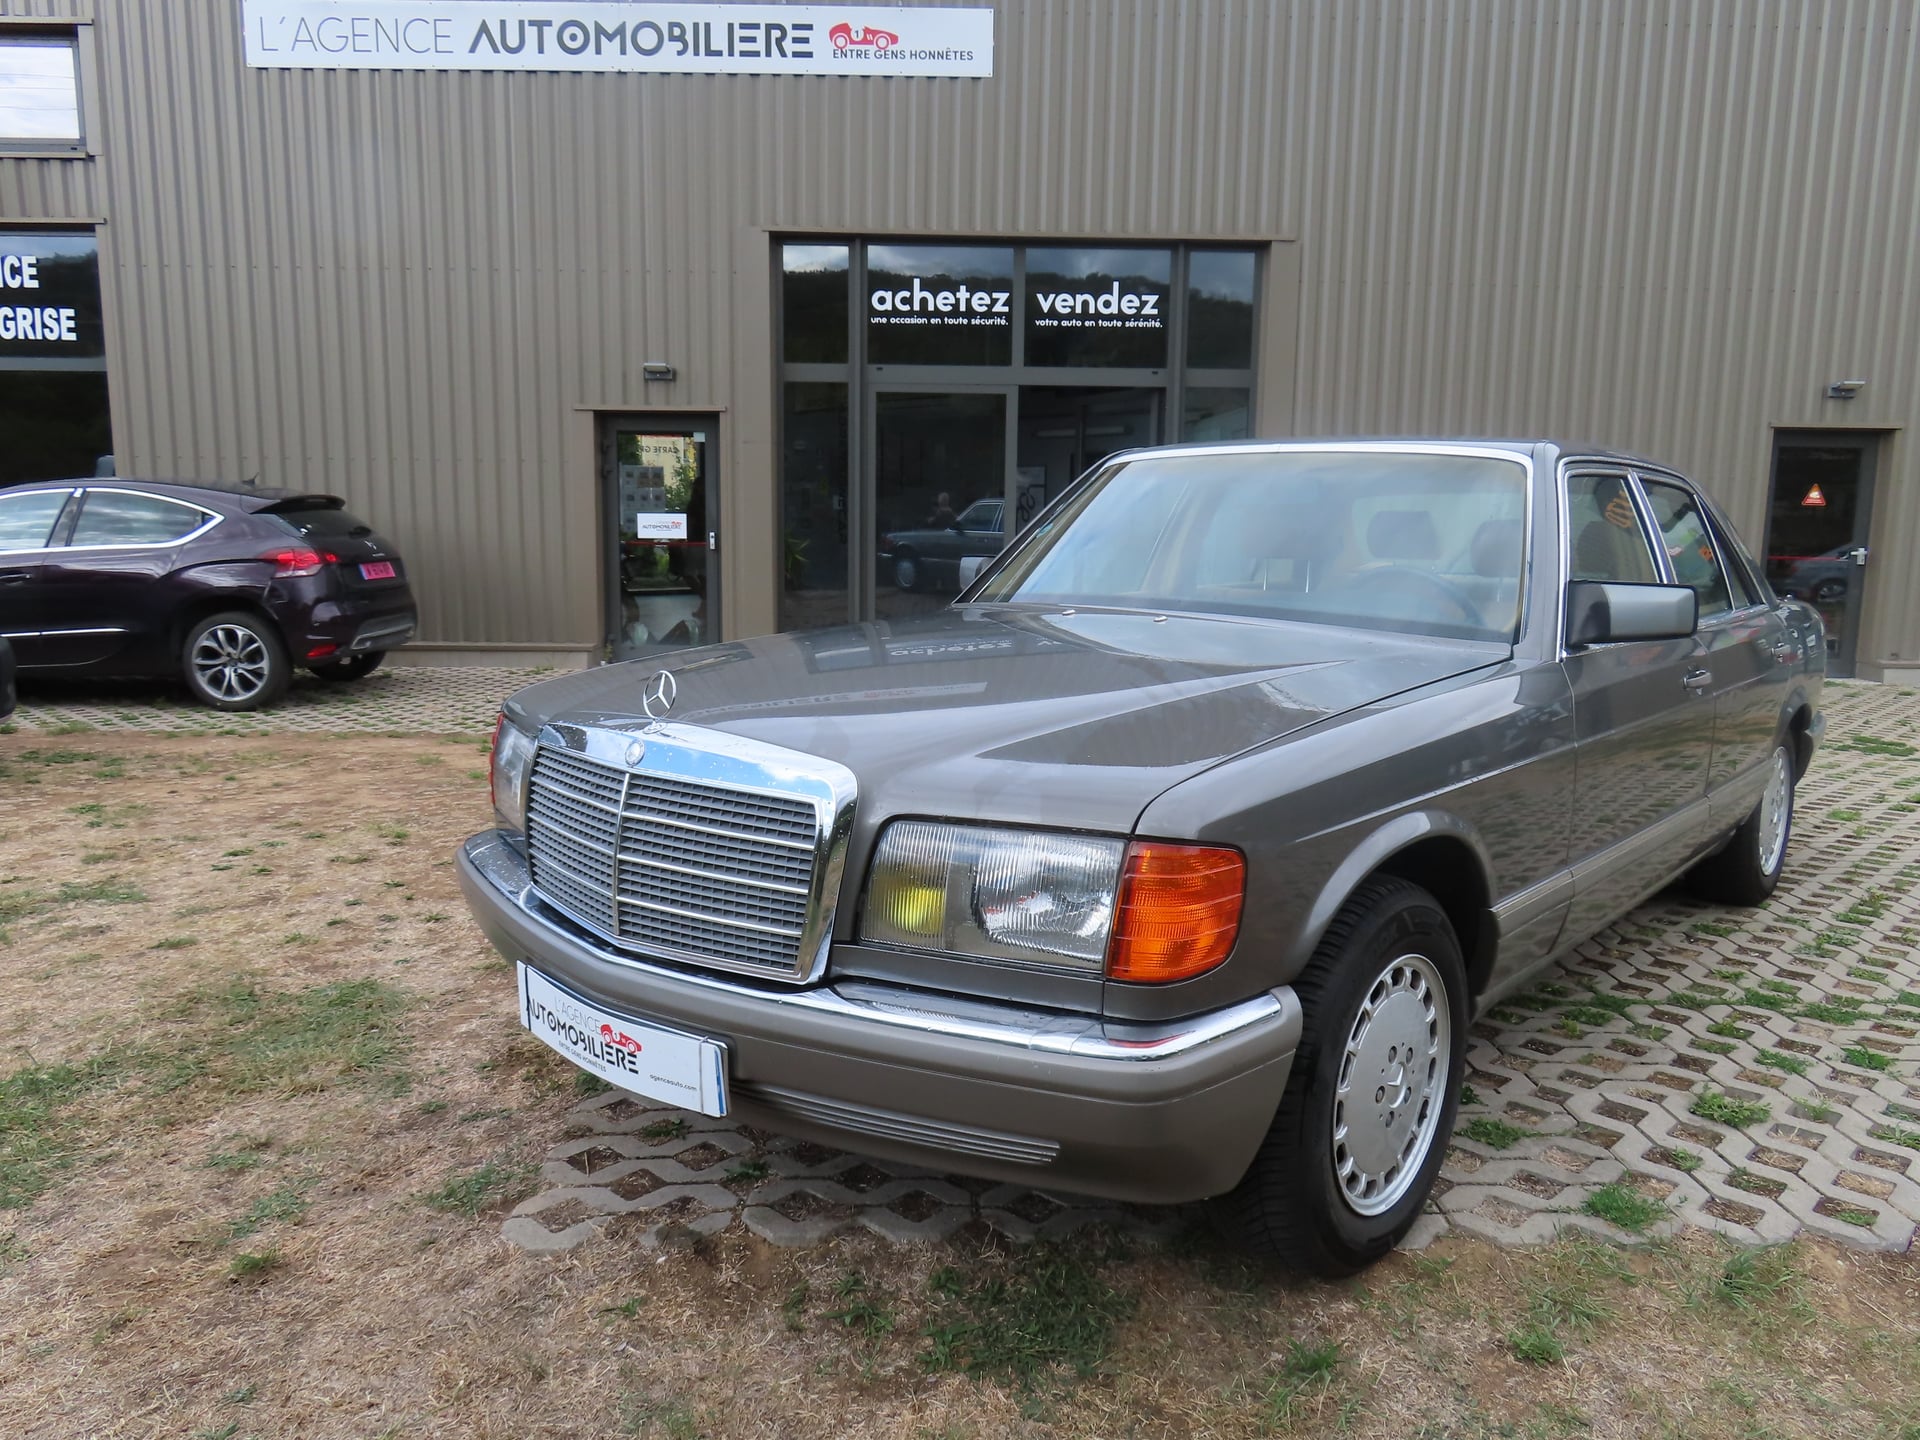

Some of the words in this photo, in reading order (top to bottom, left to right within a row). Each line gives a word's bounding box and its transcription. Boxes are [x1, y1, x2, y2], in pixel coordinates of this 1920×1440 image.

[259, 16, 454, 53] L'AGENCE
[468, 18, 814, 58] AUTOMOBILIERE
[832, 48, 870, 60] ENTRE
[874, 49, 906, 60] GENS
[909, 47, 974, 61] HONNÊTES
[871, 278, 1010, 313] achetez
[1036, 281, 1160, 315] vendez
[0, 306, 78, 342] GRISE
[870, 316, 888, 324] une
[889, 315, 928, 325] occasion
[930, 317, 942, 325] en
[944, 316, 969, 325] toute
[971, 315, 1009, 326] sécurité.
[1035, 318, 1059, 327] votre
[1061, 318, 1082, 327] auto
[1084, 319, 1096, 327] en
[1098, 319, 1123, 328] toute
[1125, 318, 1163, 328] sérénité.
